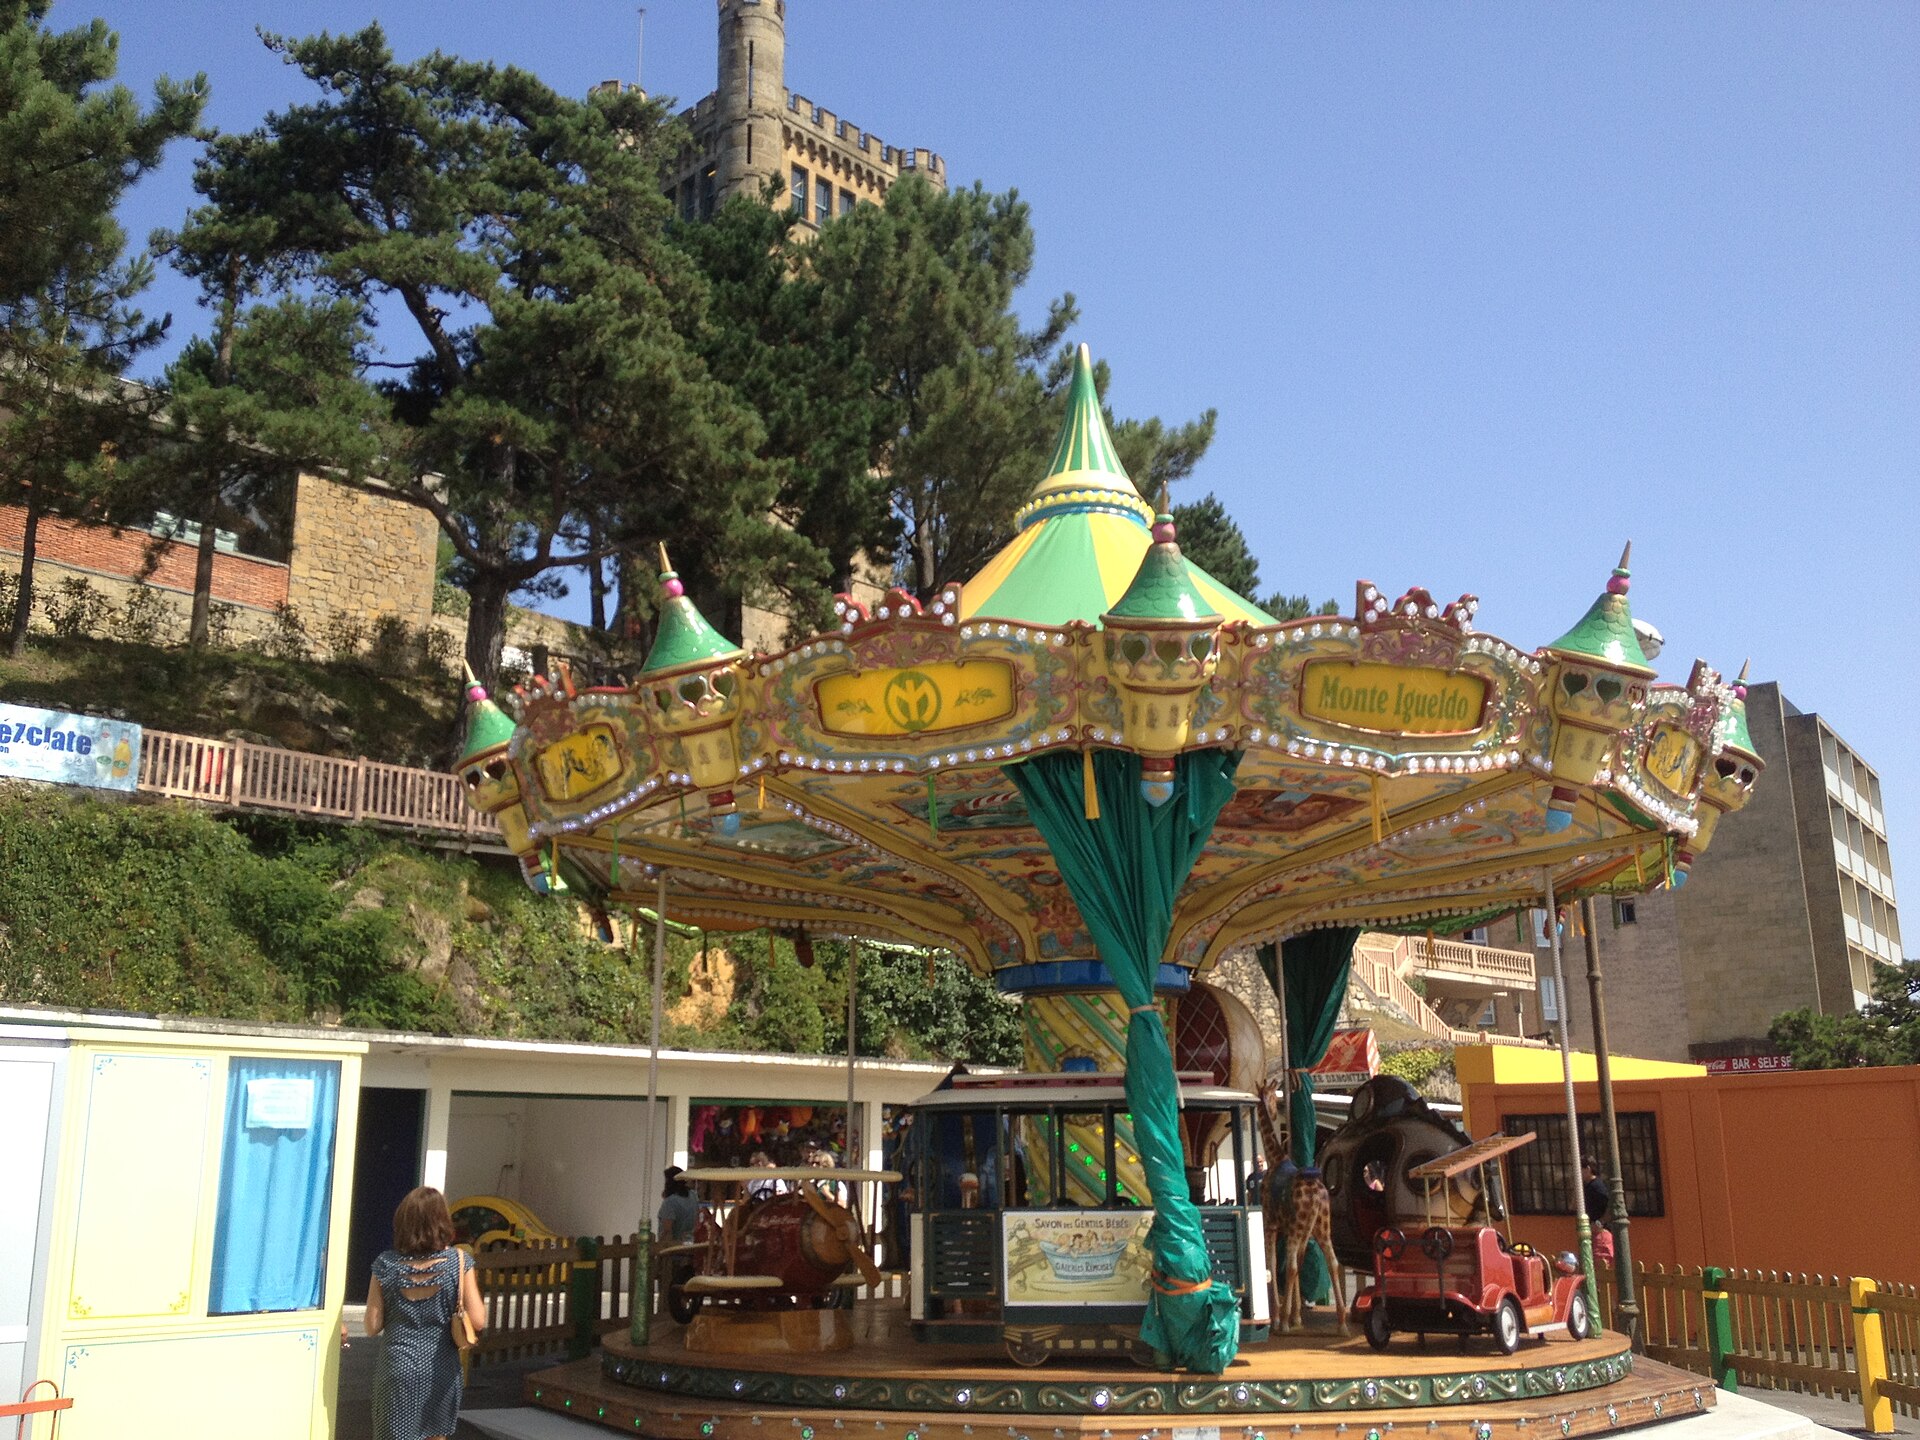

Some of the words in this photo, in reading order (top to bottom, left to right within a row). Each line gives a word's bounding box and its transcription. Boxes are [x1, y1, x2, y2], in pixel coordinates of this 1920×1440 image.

[1318, 675, 1389, 714] Monte
[1393, 682, 1468, 724] Igueldo
[1732, 1058, 1750, 1070] BAR
[1758, 1056, 1779, 1069] SELF
[1035, 1218, 1062, 1229] SAVON
[1074, 1218, 1104, 1229] GENTILS
